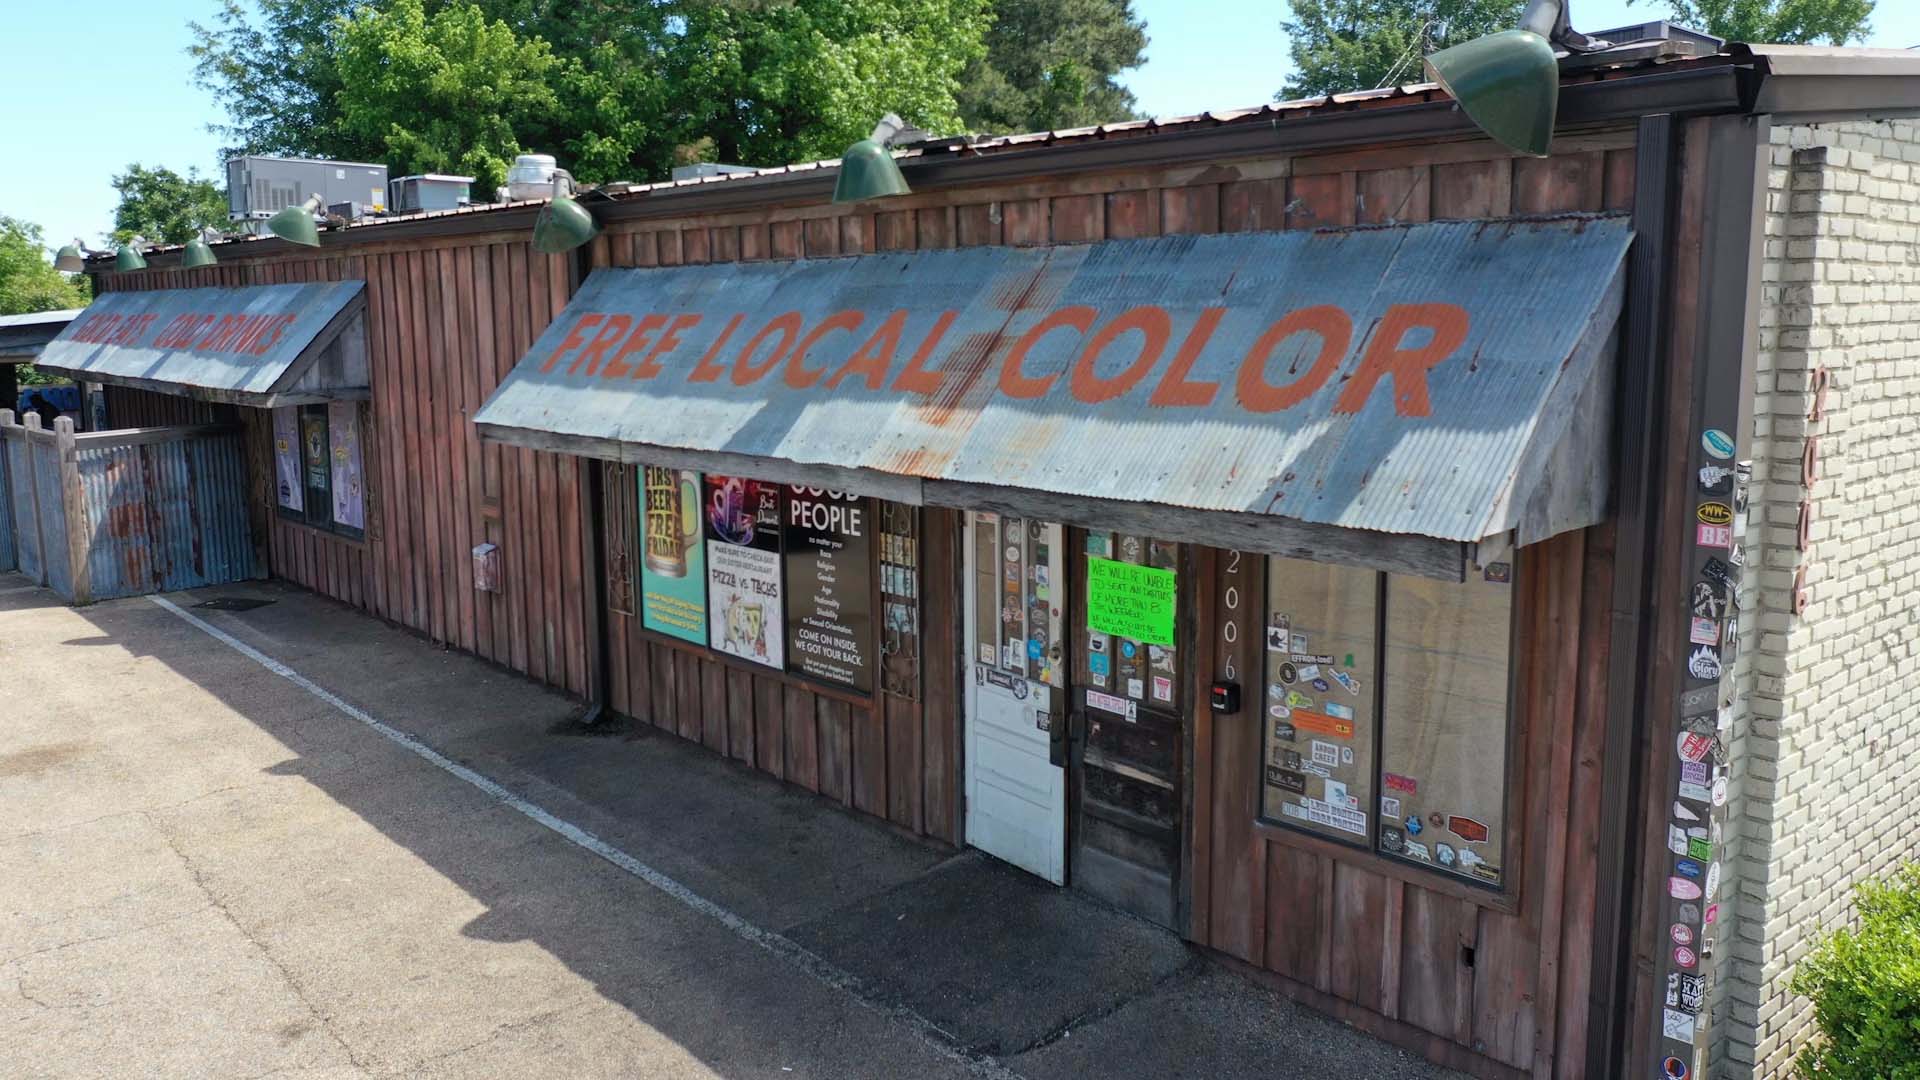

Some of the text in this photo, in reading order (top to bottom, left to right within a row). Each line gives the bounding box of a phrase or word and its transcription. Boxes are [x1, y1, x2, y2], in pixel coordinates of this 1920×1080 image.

[196, 313, 296, 356] DRINKS
[541, 303, 1470, 416] FREE LOCAL COLOR
[791, 499, 861, 537] PEOPLE
[816, 560, 836, 572] Religion
[817, 572, 836, 583] Gender
[1092, 560, 1105, 577] WE
[712, 568, 737, 588] PIZZA
[751, 576, 778, 598] TACOS
[1223, 549, 1241, 682] 2006
[795, 640, 864, 667] WE GOT YOUR BACK.
[799, 628, 858, 654] COME ON INSIDE,
[1693, 660, 1719, 675] Glory
